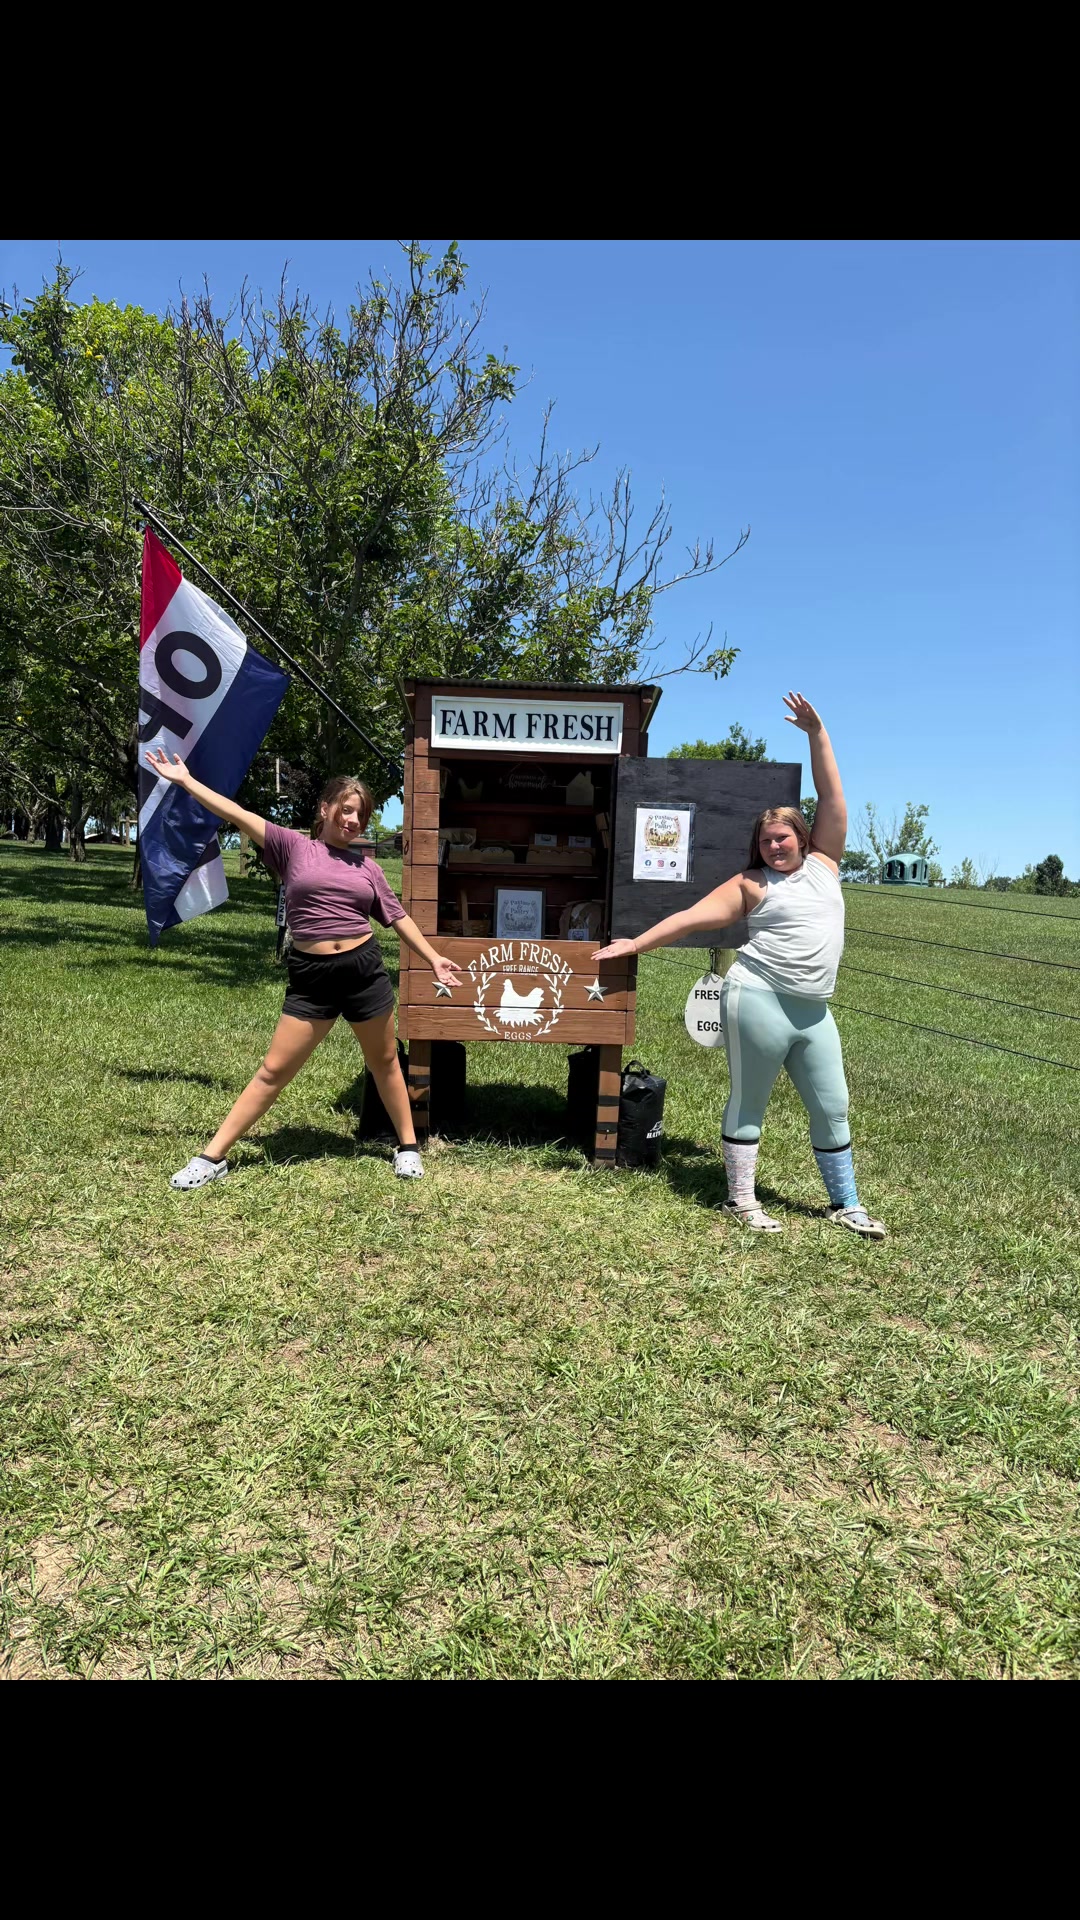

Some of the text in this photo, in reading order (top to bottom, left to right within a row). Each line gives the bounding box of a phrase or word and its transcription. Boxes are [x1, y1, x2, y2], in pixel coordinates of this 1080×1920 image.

[440, 709, 615, 742] FARM FRESH
[467, 942, 574, 986] FARM FRESH
[502, 964, 540, 976] FREE RANGE
[694, 989, 720, 1001] FRES
[504, 1031, 532, 1041] EGGS
